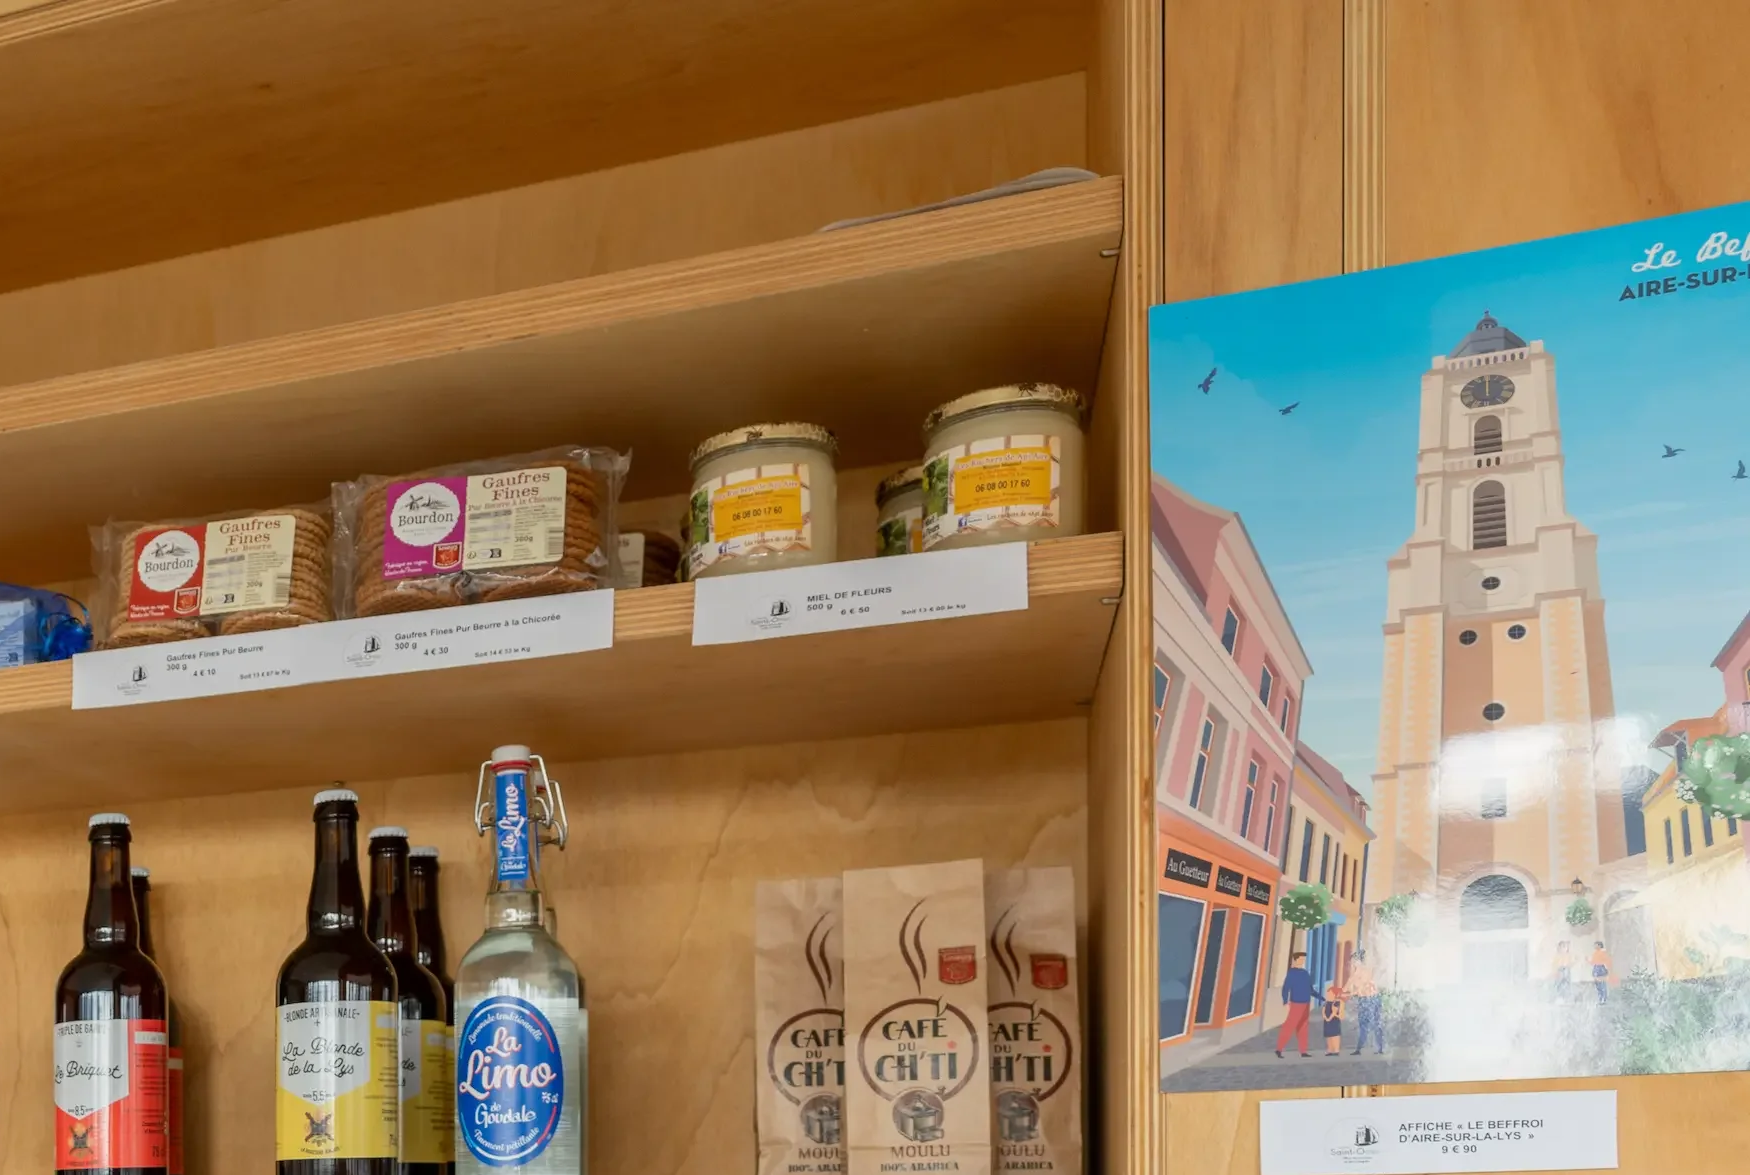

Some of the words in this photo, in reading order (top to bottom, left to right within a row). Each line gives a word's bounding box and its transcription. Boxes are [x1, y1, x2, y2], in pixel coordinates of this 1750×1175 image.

[1631, 242, 1682, 273] Le
[1618, 264, 1750, 302] AIRE-SUR-
[482, 471, 551, 490] Gaufres
[975, 484, 984, 493] 06
[986, 482, 996, 491] 08
[997, 481, 1008, 490] 00
[1009, 480, 1018, 488] 17
[1020, 479, 1031, 488] 60
[492, 486, 540, 502] Fines
[219, 518, 282, 535] Gaufres
[398, 511, 455, 528] Bourdon
[227, 532, 271, 547] Fines
[144, 557, 194, 574] Bourdon
[807, 594, 831, 603] MIEL
[834, 591, 848, 600] DE
[851, 587, 892, 598] FLEURS
[807, 603, 824, 611] 500
[858, 606, 870, 614] 50
[395, 631, 428, 642] Gaufres
[430, 627, 453, 637] Fines
[456, 624, 470, 634] Pur
[473, 621, 502, 632] Beurre
[504, 620, 510, 628] à
[512, 618, 519, 626] la
[522, 613, 561, 625] Chicorée
[166, 652, 196, 663] Gaufres
[199, 650, 220, 659] Fines
[222, 648, 236, 656] Pur
[238, 645, 264, 655] Beurre
[395, 642, 409, 650] 300
[438, 647, 449, 655] 30
[1167, 857, 1178, 872] Au
[1179, 860, 1210, 883] Guetteur
[467, 1013, 496, 1045] Limonade
[495, 1011, 543, 1043] traditionnelle
[282, 1041, 306, 1062] La
[310, 1036, 365, 1057] Blonde
[485, 1026, 522, 1058] La
[898, 1042, 916, 1052] DU
[994, 1044, 1012, 1054] DU
[806, 1050, 823, 1059] DU
[288, 1061, 301, 1076] de
[303, 1061, 322, 1074] la
[324, 1057, 354, 1078] Lys
[874, 1050, 958, 1082] CH'TI
[459, 1049, 558, 1101] Limo
[490, 1102, 502, 1112] de
[474, 1102, 538, 1129] Goudale
[1399, 1120, 1453, 1132] AFFICHE
[1467, 1120, 1484, 1130] LE
[1488, 1118, 1544, 1131] BEFFROI
[474, 1128, 504, 1152] Finement
[505, 1127, 540, 1154] pétillante
[1398, 1132, 1521, 1143] D'AIRE-SUR-LA-LYS
[891, 1145, 950, 1157] MOULU
[1441, 1145, 1448, 1154] 9
[1452, 1145, 1459, 1154] €
[1462, 1144, 1478, 1154] 90
[880, 1163, 907, 1172] 100%
[910, 1162, 959, 1171] ARABICA
[1004, 1162, 1053, 1171] ARABICA
